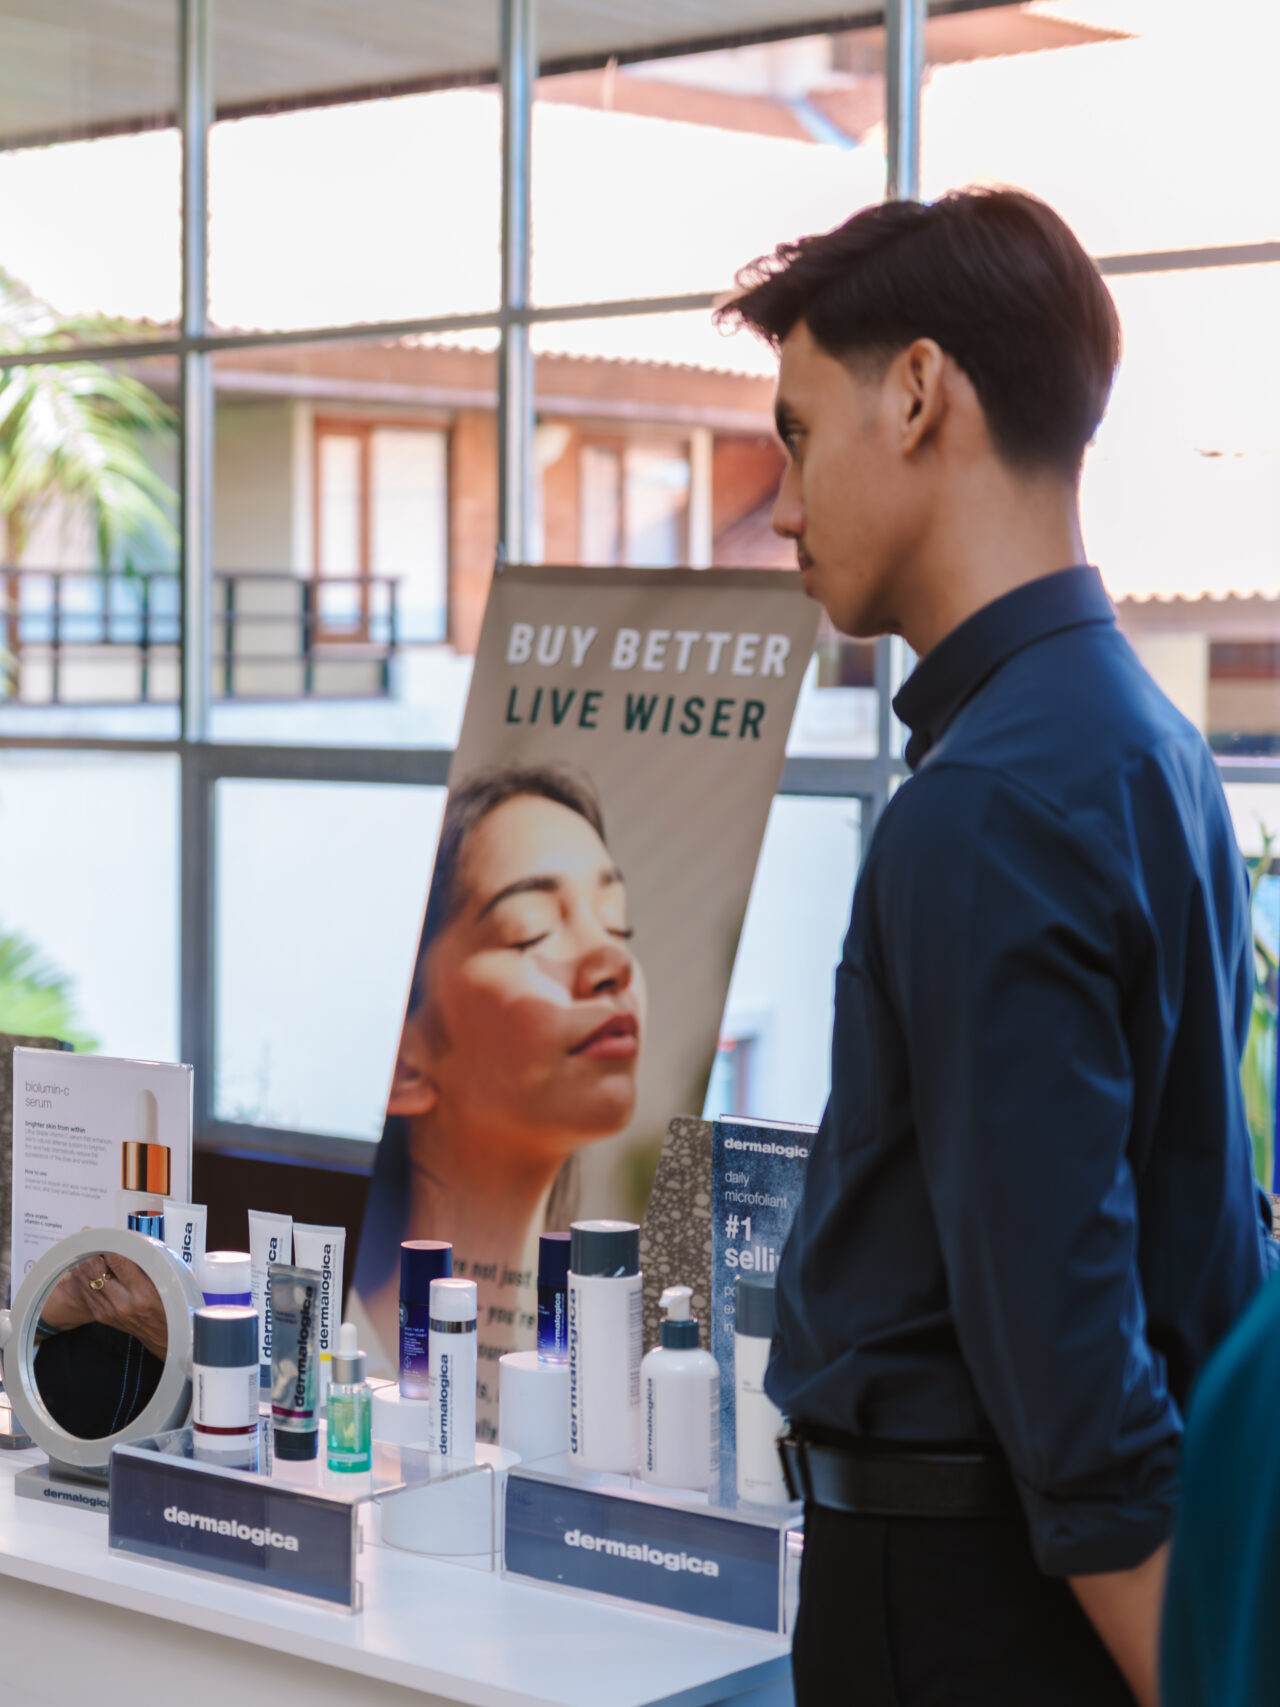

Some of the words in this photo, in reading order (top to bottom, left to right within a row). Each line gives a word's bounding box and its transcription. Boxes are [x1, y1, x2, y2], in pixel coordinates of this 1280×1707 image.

[506, 623, 597, 668] BUY
[611, 628, 791, 678] BETTER
[505, 686, 604, 729] LIVE
[625, 693, 766, 740] WISER
[25, 1098, 52, 1109] serum
[724, 1138, 810, 1158] dermalogic
[725, 1171, 750, 1187] daily
[725, 1190, 788, 1209] microfoliant
[182, 1222, 193, 1263] gica
[725, 1214, 752, 1241] #1
[724, 1246, 780, 1272] selli
[320, 1244, 332, 1350] dermalogica
[295, 1286, 313, 1408] dermalogica
[570, 1288, 578, 1454] dermalogica
[439, 1354, 449, 1455] dermalogica
[163, 1505, 299, 1552] dermalogica
[564, 1528, 719, 1578] dermalogica
